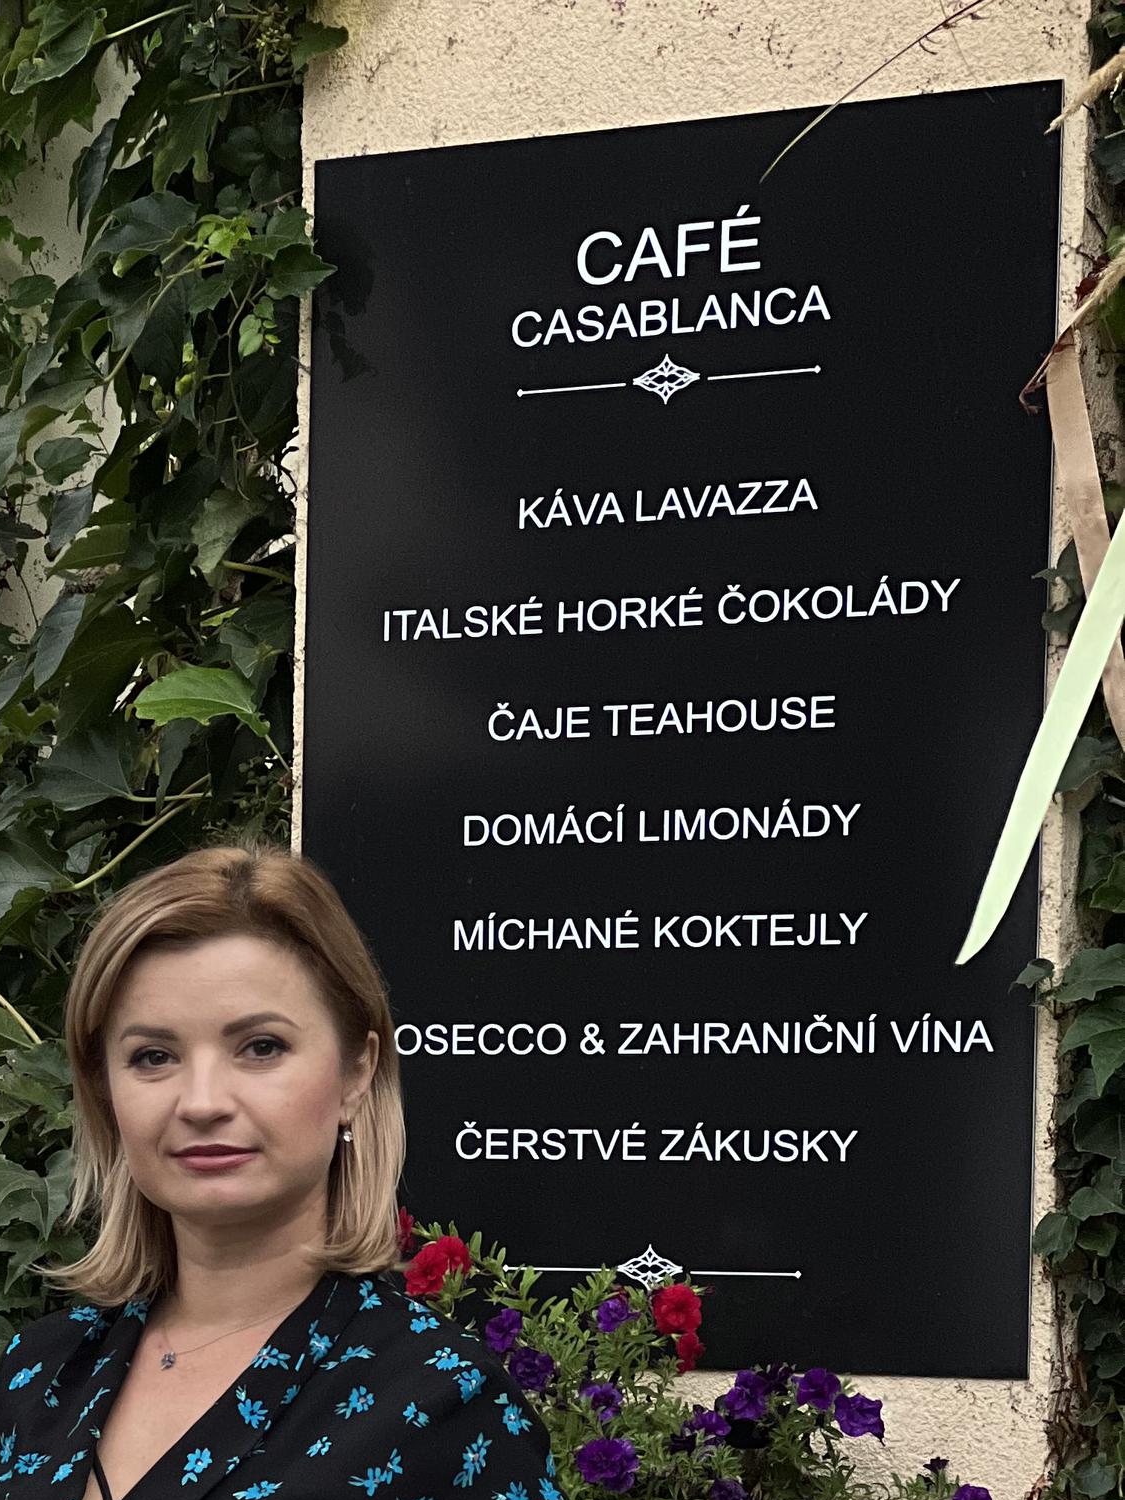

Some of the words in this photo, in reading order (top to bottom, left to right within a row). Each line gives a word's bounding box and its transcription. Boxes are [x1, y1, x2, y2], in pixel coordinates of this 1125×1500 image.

[577, 205, 760, 285] CAFÉ
[512, 285, 830, 347] CASABLANCA
[519, 488, 624, 529] KÁVA
[636, 479, 818, 521] LAVAZZA
[384, 596, 543, 641] ITALSKÉ
[558, 587, 703, 633] HORKÉ
[718, 576, 960, 624] ČOKOLÁDY
[489, 703, 590, 741] ČAJE
[603, 696, 835, 736] TEAHOUSE
[464, 804, 624, 846] DOMÁCÍ
[639, 799, 861, 841] LIMONÁDY
[454, 910, 639, 950] MÍCHANÉ
[655, 913, 868, 947] KOKTEJLY
[393, 1024, 566, 1055] OSECCO
[580, 1023, 605, 1054] &
[618, 1014, 877, 1054] ZAHRANIČNÍ
[890, 1013, 994, 1052] VÍNA
[456, 1121, 646, 1160] ČERSTVÉ
[659, 1122, 858, 1162] ZÁKUSKY
